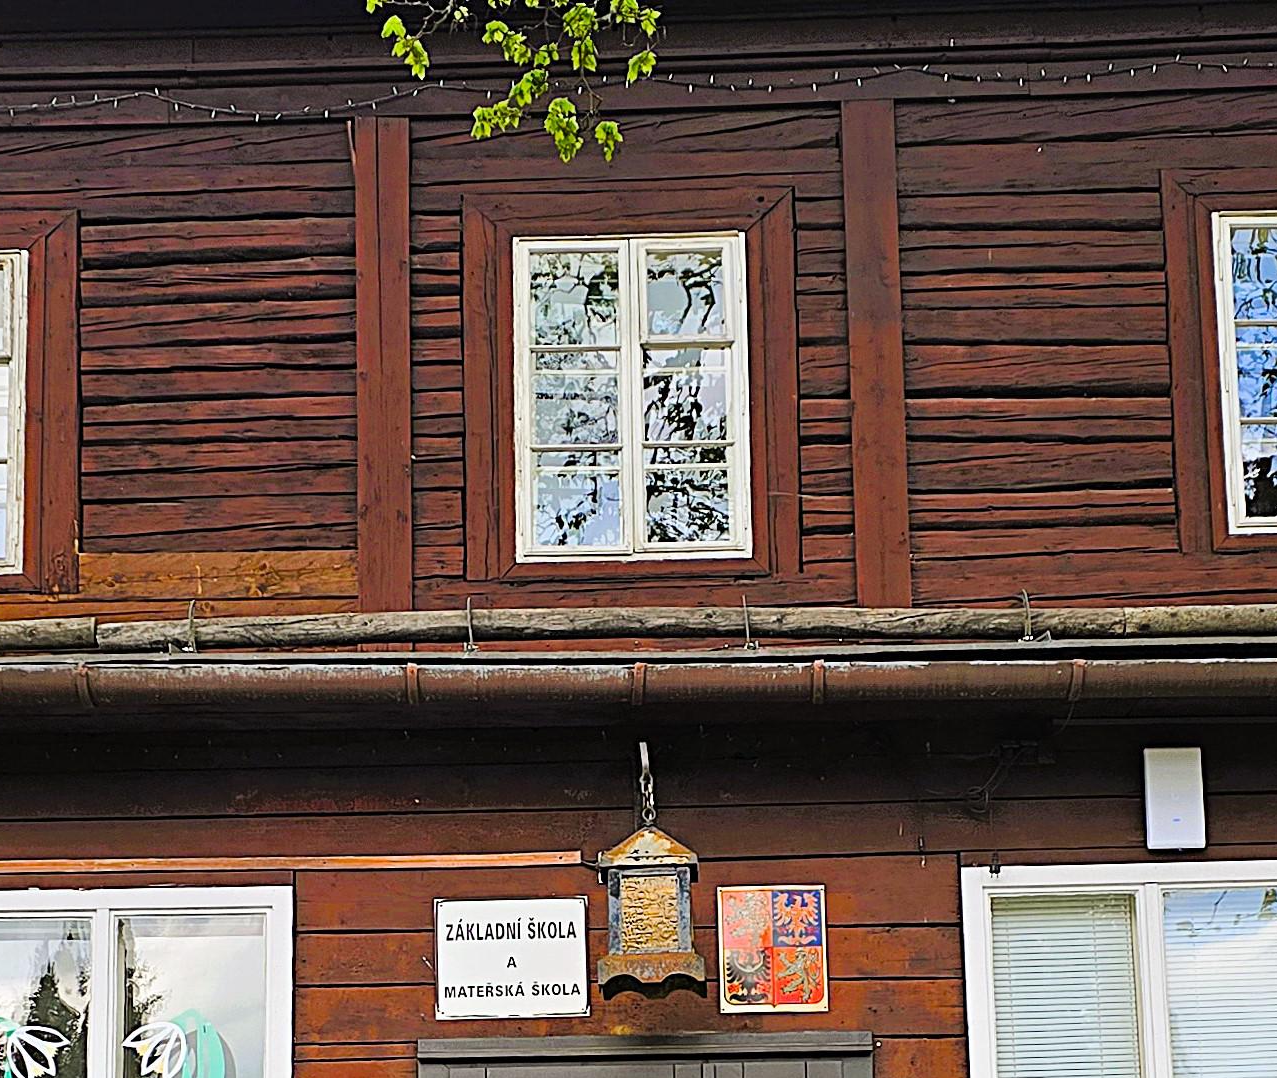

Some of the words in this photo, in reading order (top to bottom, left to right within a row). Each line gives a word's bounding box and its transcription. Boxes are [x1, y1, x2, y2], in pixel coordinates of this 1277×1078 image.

[445, 918, 522, 941] ZÁKLADNÍ
[527, 917, 577, 940] ŠKOLA
[506, 956, 517, 969] A
[444, 981, 525, 998] MATEŘSKÁ
[531, 981, 581, 997] ŠKOLA
